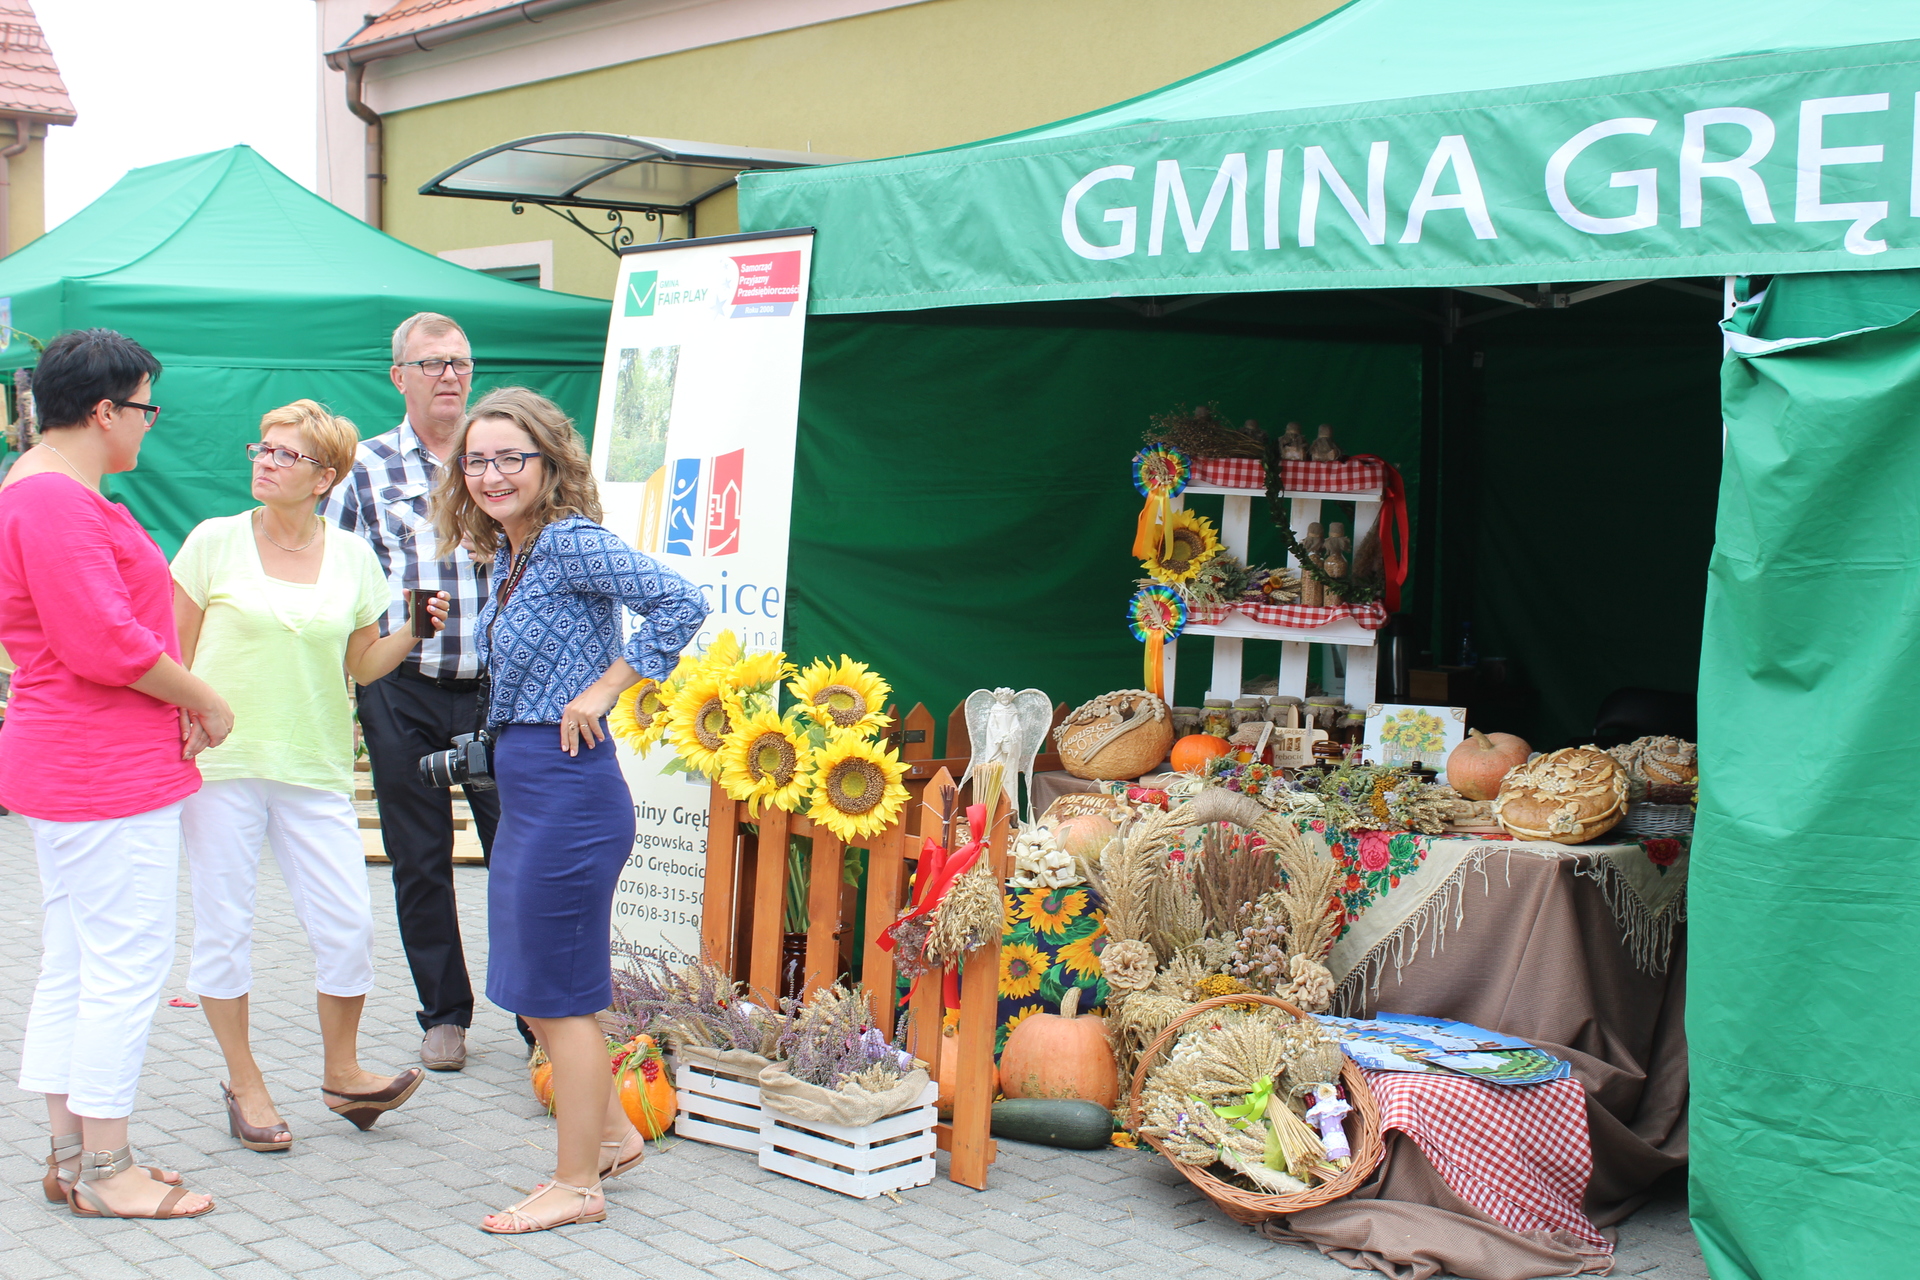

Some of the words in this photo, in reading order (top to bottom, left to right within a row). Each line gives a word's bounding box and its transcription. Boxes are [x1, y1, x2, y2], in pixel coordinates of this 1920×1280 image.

[1061, 134, 1498, 260] GMINA
[1545, 91, 1920, 256] GRĘ
[740, 261, 773, 273] Samorząd
[659, 279, 680, 289] GMINA
[738, 275, 770, 285] Przyjazny
[658, 291, 681, 305] FAIR
[682, 288, 708, 304] PLAY
[635, 833, 694, 852] ogowska
[616, 900, 702, 928] (076)8-315-0
